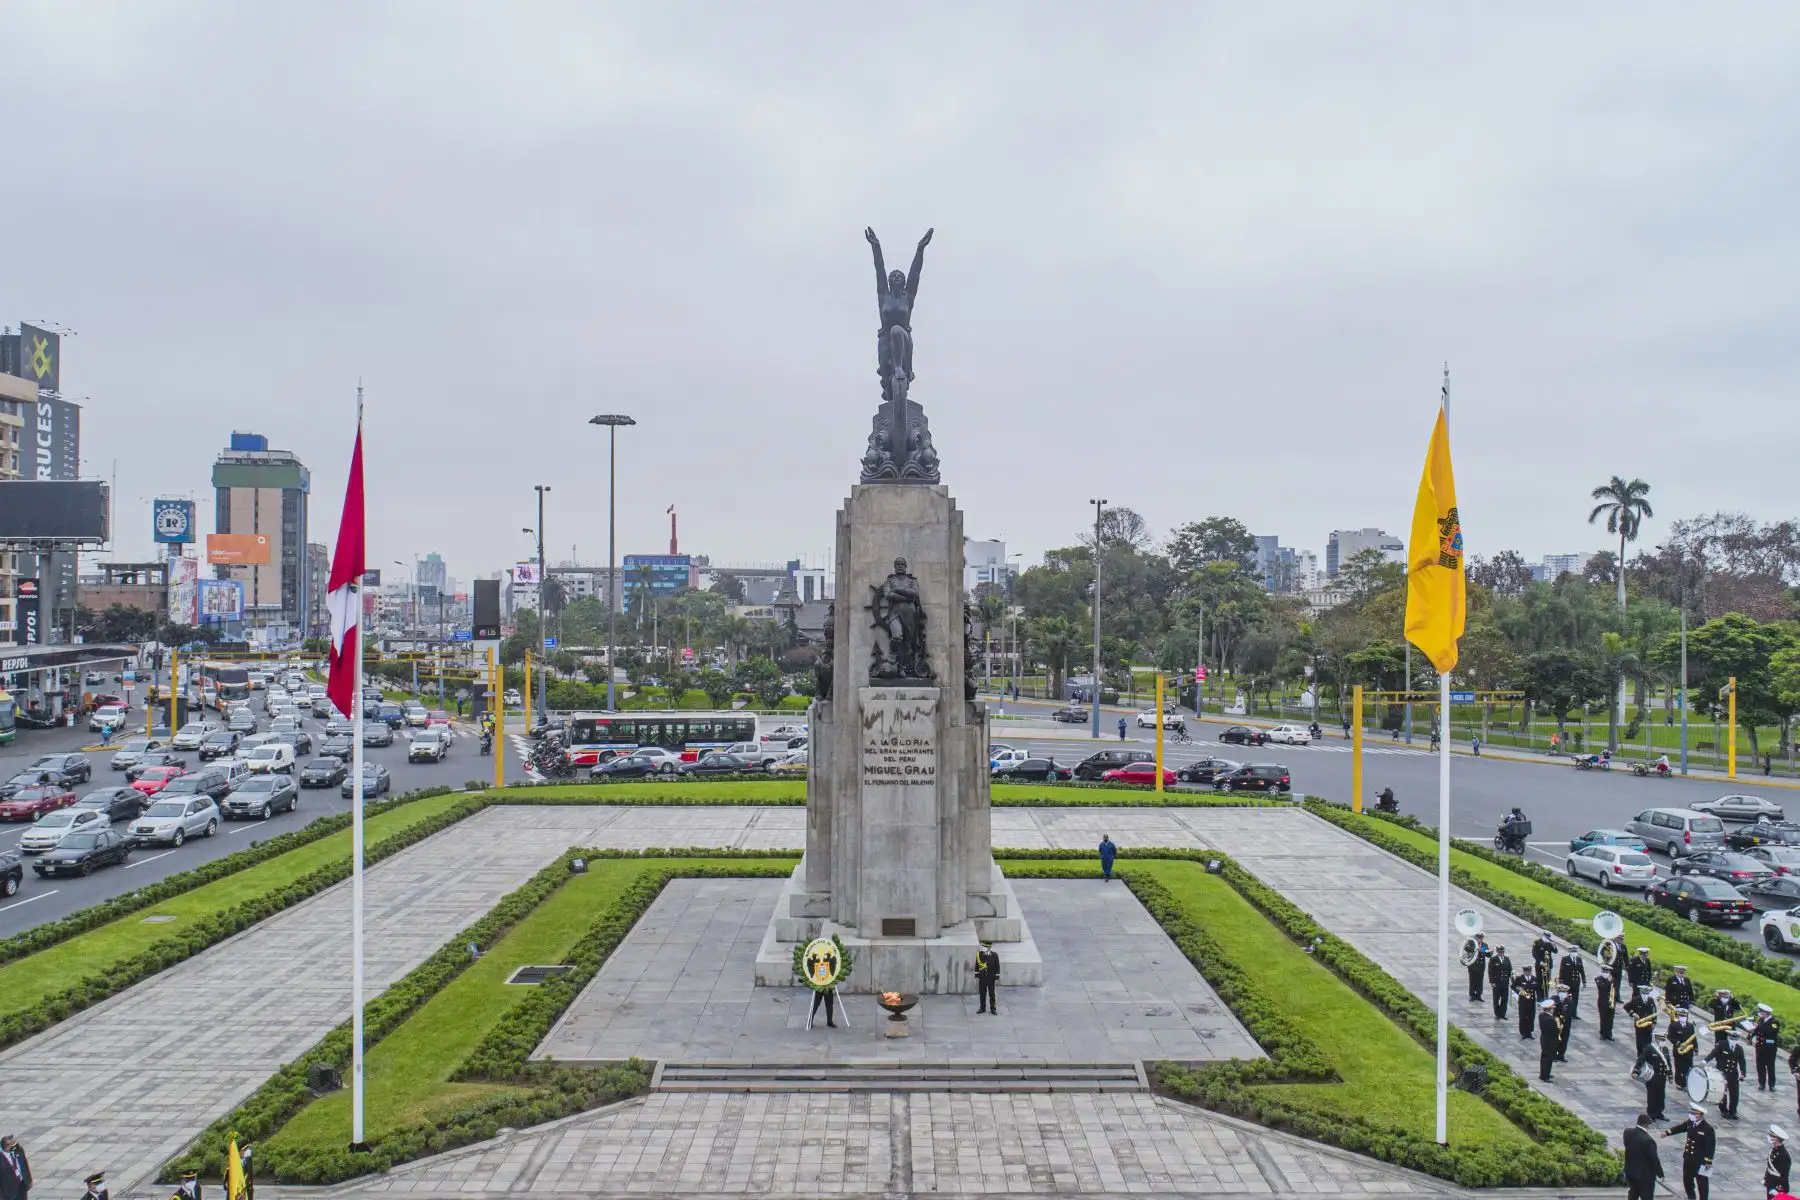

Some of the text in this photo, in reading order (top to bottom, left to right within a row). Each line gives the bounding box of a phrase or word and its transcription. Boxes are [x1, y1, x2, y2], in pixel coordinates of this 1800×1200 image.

[2, 657, 28, 671] REPSOL
[864, 766, 934, 774] MIGUEL GRAU
